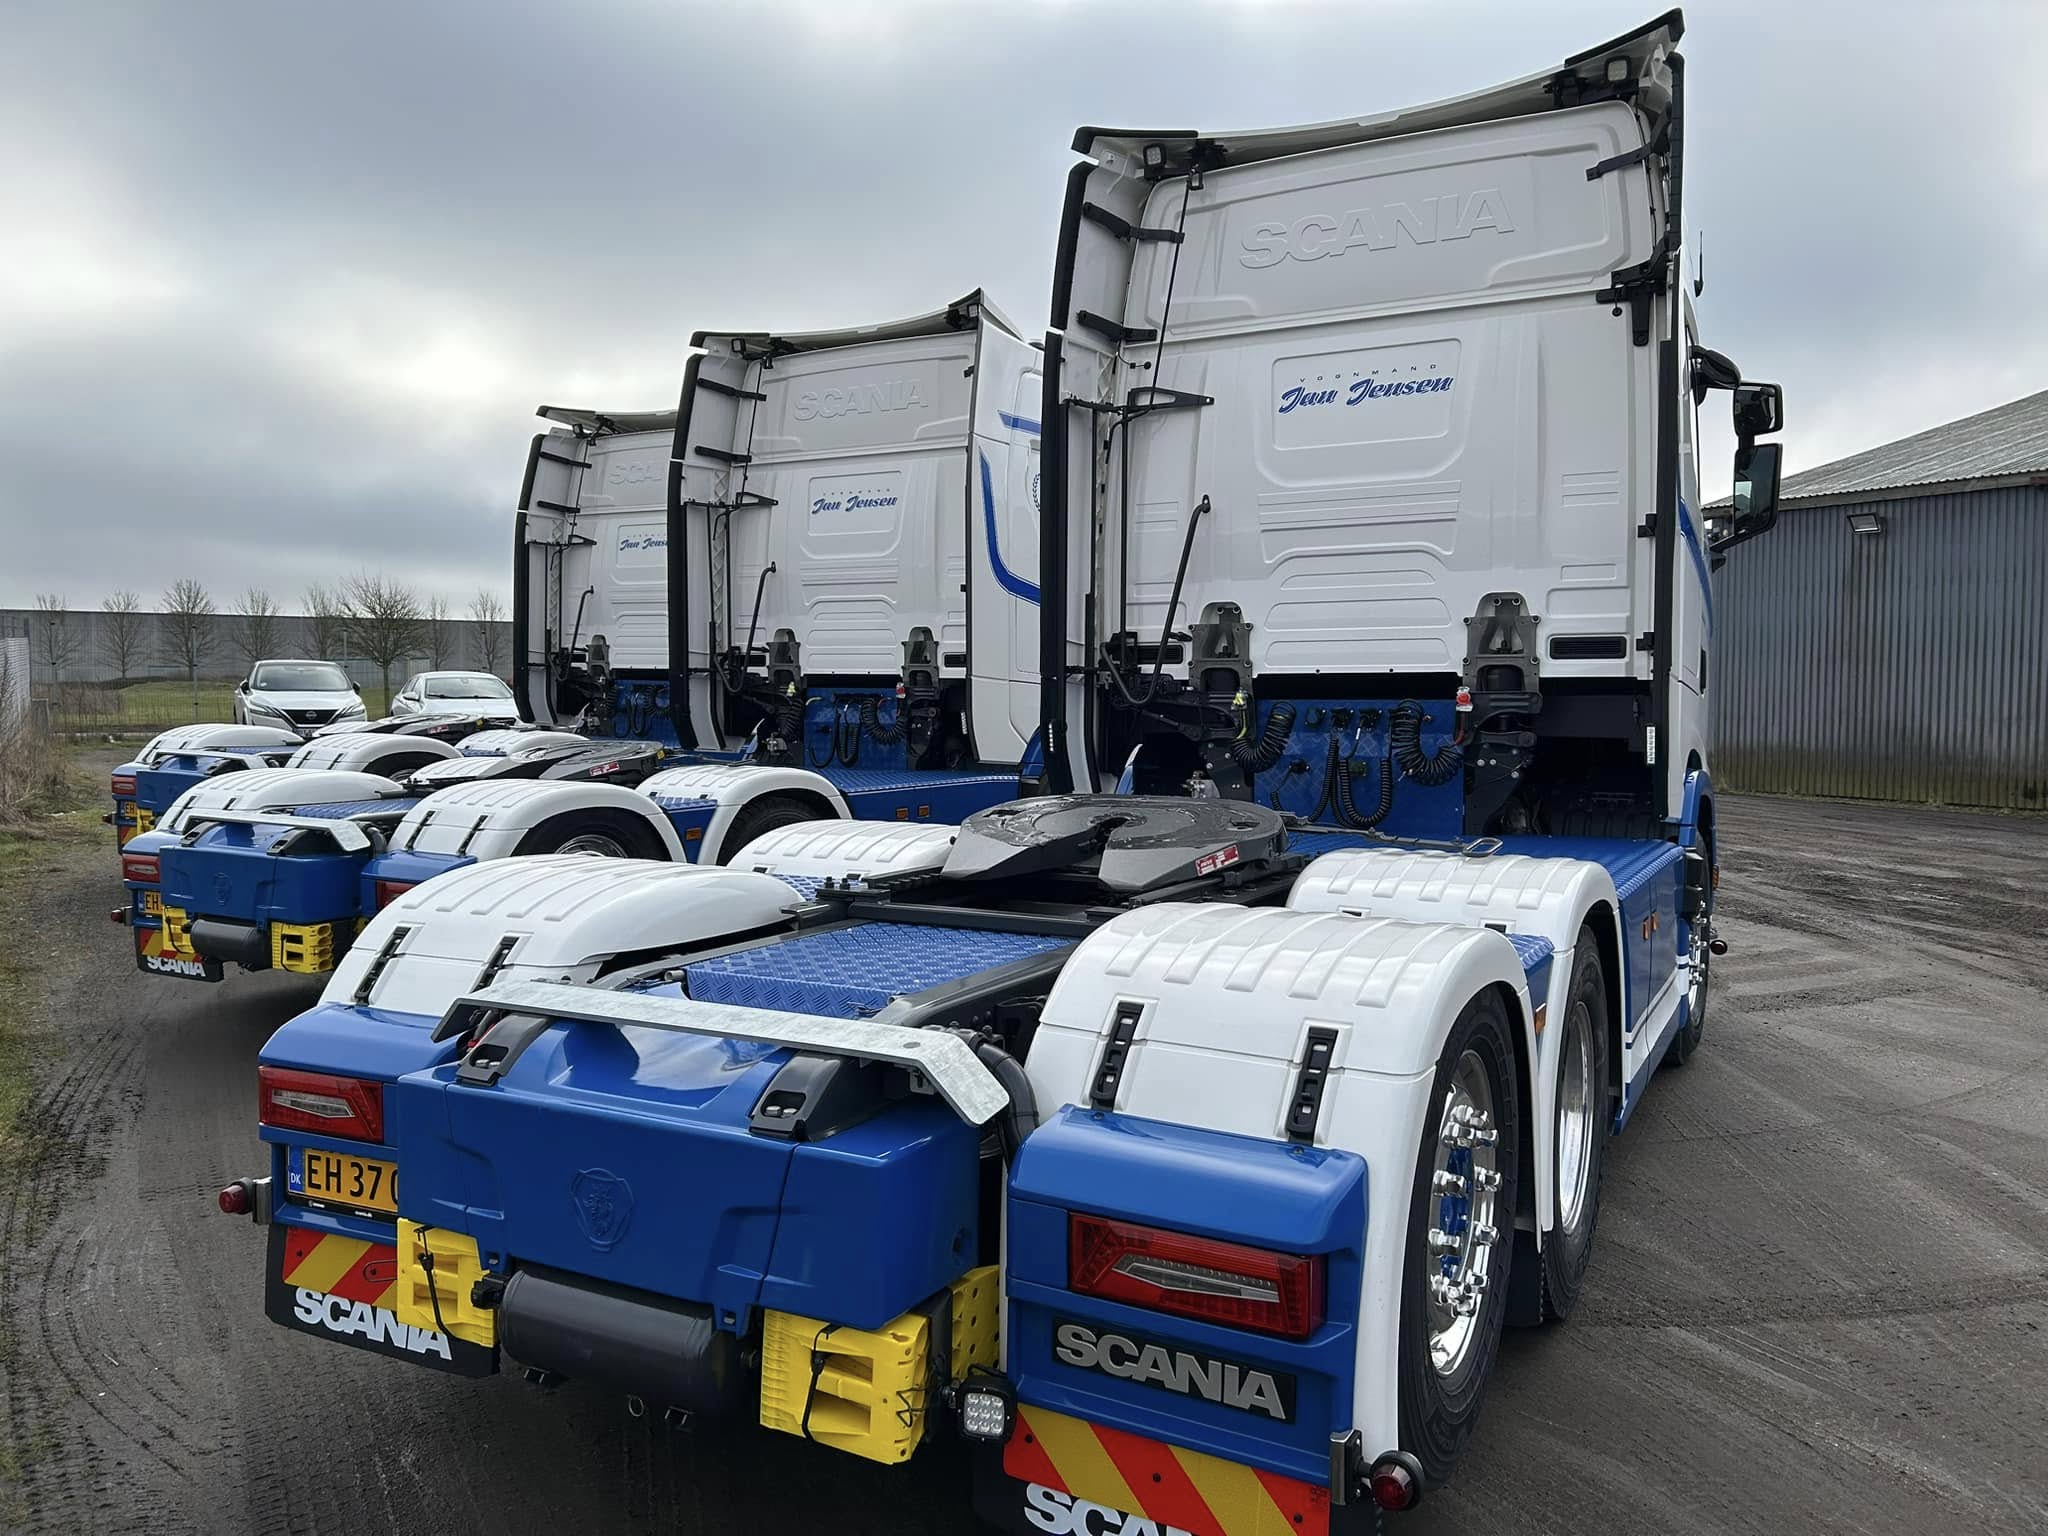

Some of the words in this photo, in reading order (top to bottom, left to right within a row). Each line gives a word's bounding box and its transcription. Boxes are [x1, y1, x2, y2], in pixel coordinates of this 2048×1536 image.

[1240, 188, 1516, 269] SCANIA
[1299, 363, 1437, 383] VOGNMAND
[794, 378, 929, 421] SCANIA
[1278, 386, 1338, 414] Jan
[1346, 377, 1454, 407] Jensen
[811, 498, 842, 515] Jan
[845, 495, 898, 512] Jensen
[642, 537, 668, 550] Jens
[145, 894, 159, 911] EH
[146, 955, 206, 977] SCANIA
[290, 1172, 302, 1185] DK
[307, 1153, 342, 1194] EH
[349, 1161, 383, 1201] 37
[294, 1286, 453, 1361] SCANIA
[1056, 1324, 1287, 1420] SCANIA
